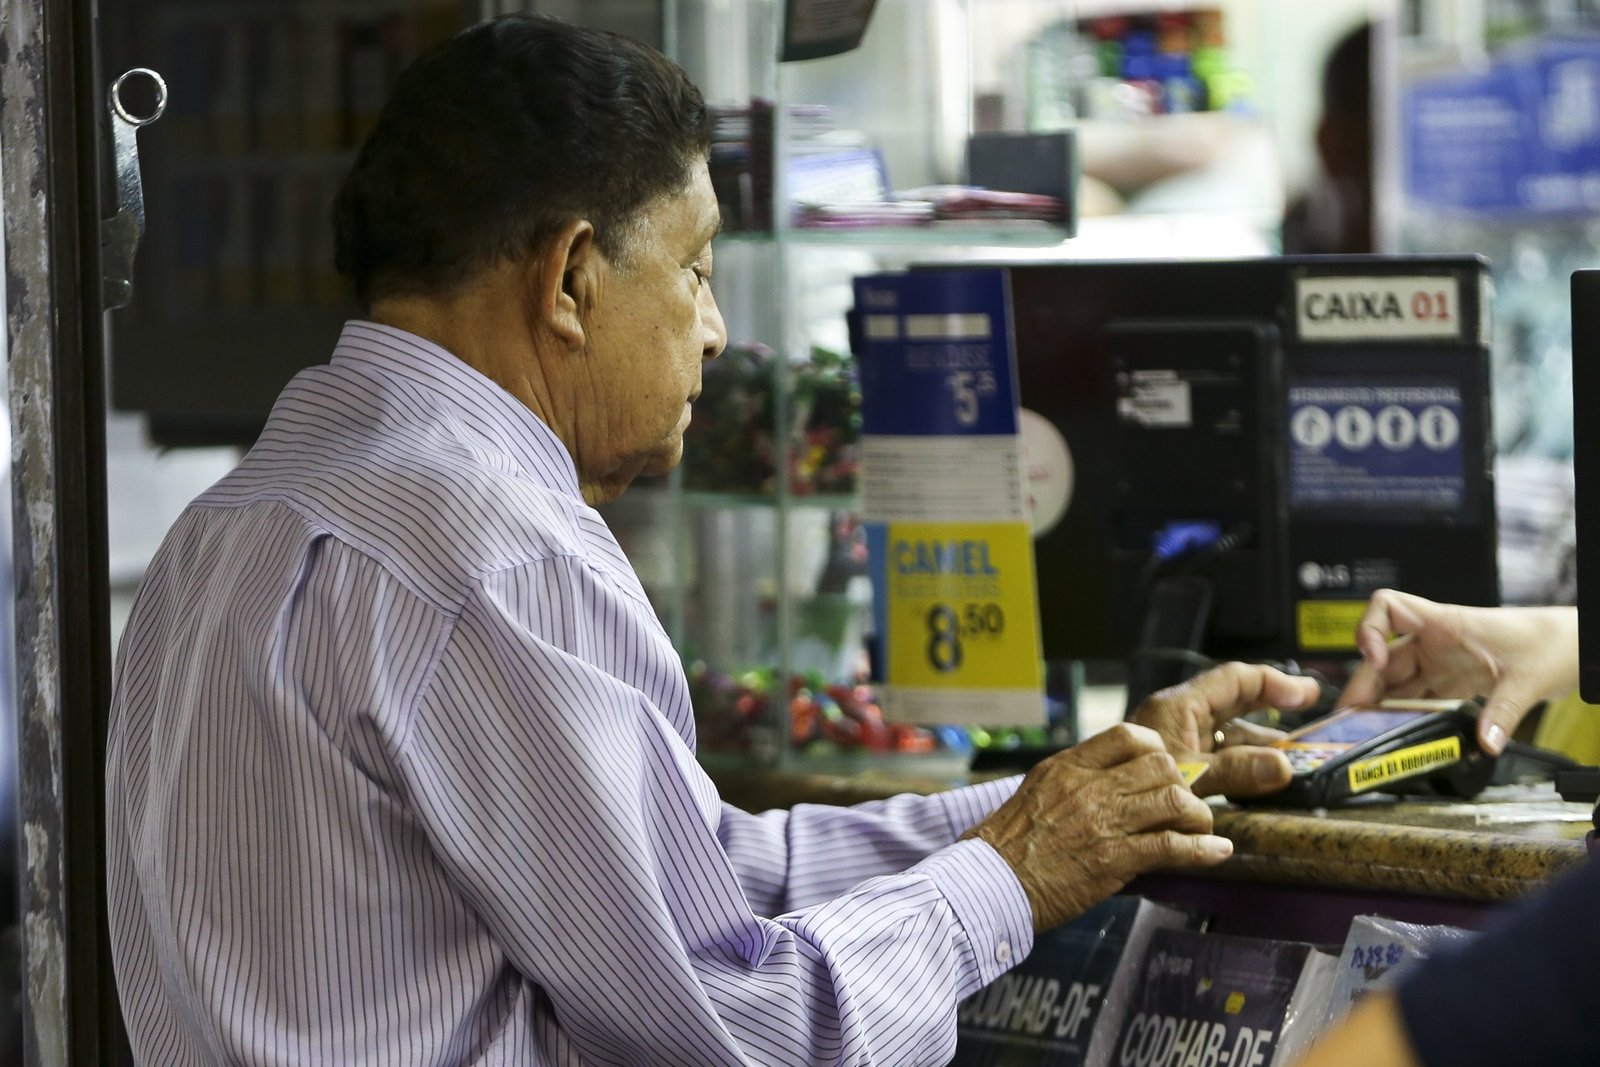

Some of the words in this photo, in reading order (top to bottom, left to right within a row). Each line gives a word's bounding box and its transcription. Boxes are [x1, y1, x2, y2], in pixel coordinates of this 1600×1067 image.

[1305, 291, 1404, 321] CAIXA
[1411, 291, 1450, 320] 01
[895, 540, 998, 575] CAMEL
[1120, 1012, 1273, 1067] CODHAB-DF
